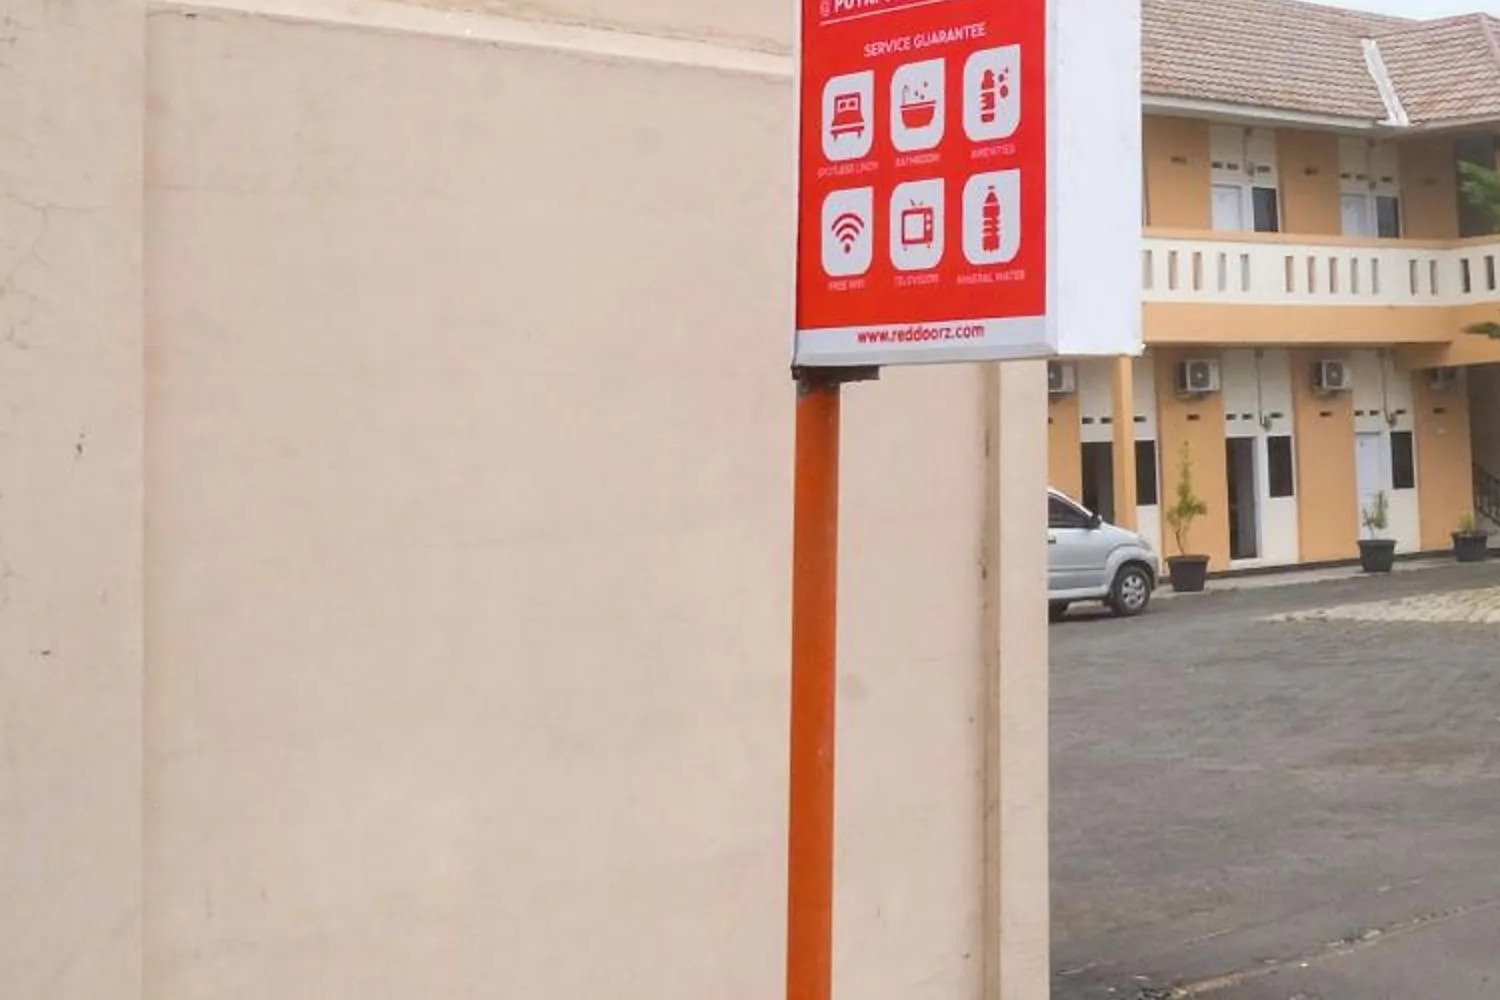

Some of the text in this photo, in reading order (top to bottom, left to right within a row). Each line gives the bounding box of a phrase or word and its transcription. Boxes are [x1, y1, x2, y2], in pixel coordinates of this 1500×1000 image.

[864, 22, 986, 57] SERVICE GUARANTEE
[857, 324, 985, 344] www.reddoorz.com
